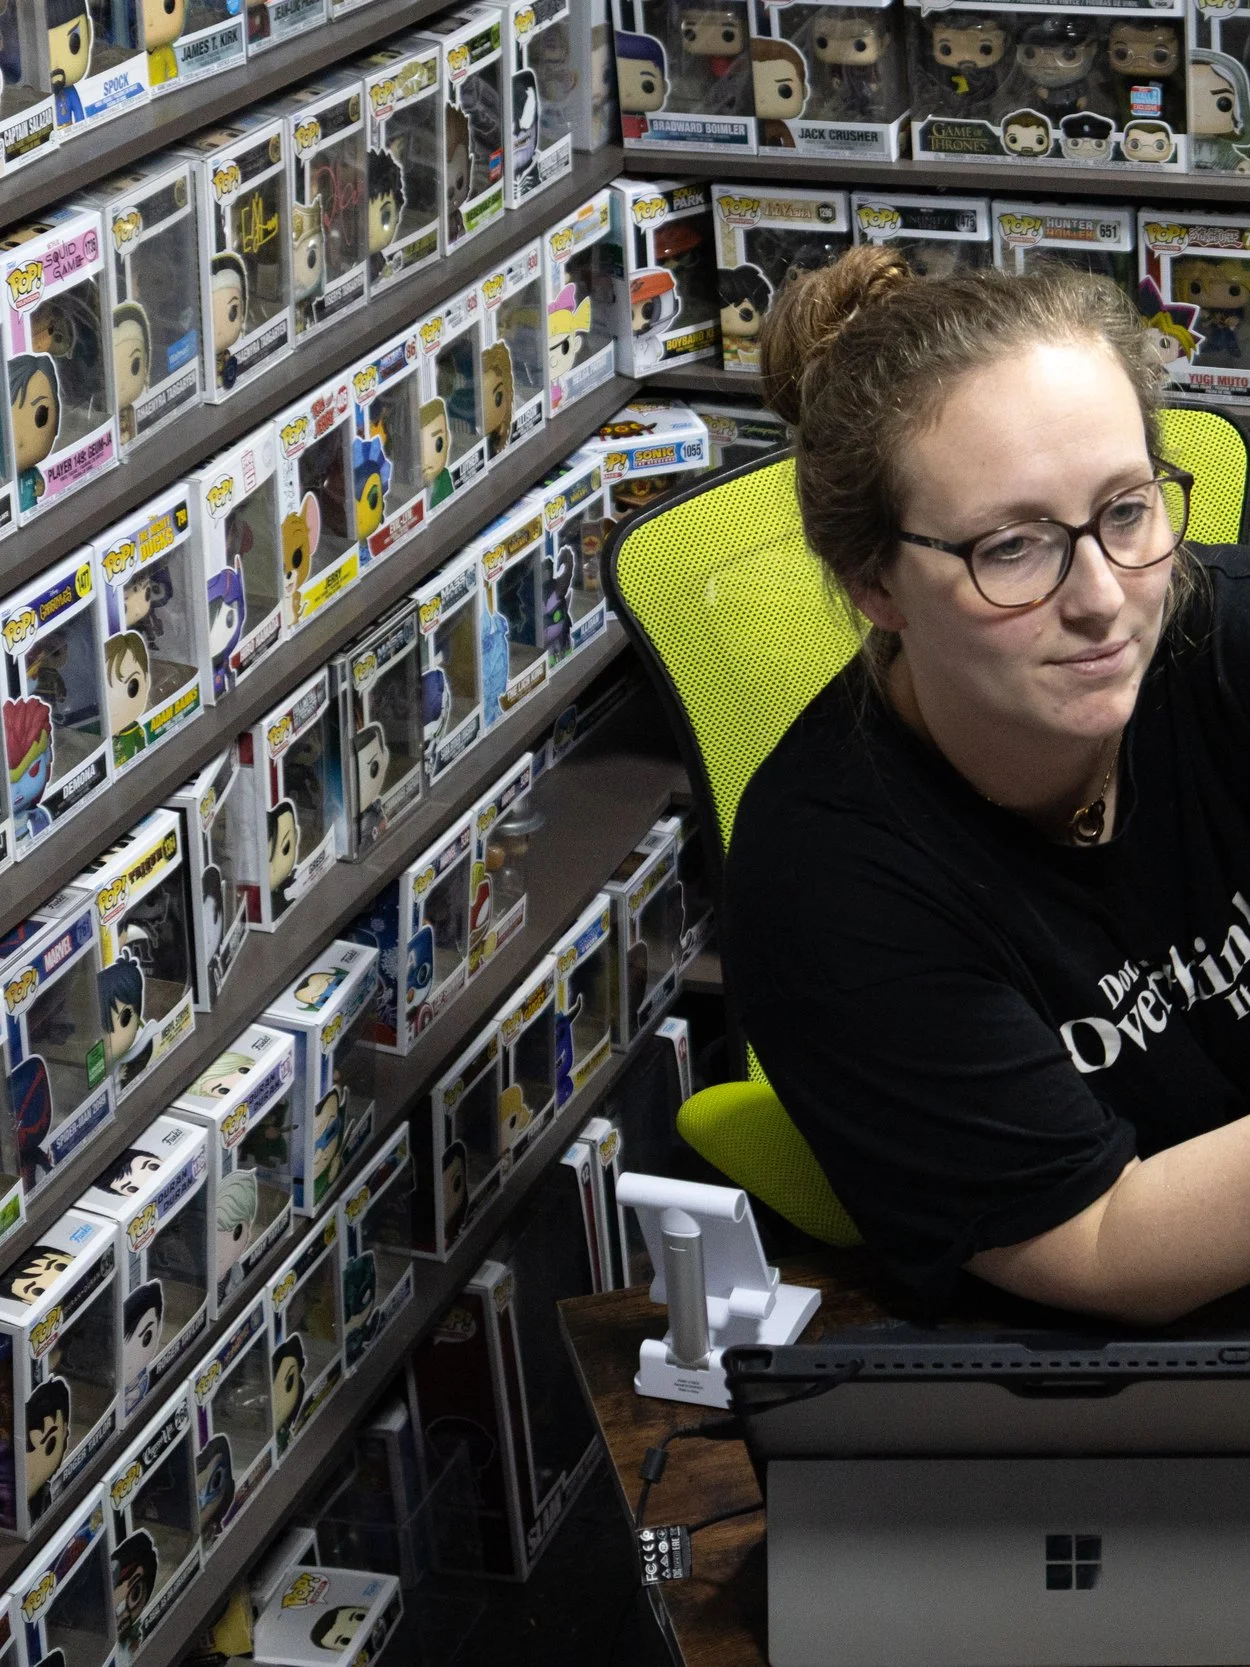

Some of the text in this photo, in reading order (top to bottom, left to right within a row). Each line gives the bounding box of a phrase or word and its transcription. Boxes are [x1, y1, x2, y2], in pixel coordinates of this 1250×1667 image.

[181, 28, 238, 61] JAMES KIRK
[103, 72, 129, 96] SPOCK
[3, 121, 28, 147] CAPTAIN
[294, 118, 321, 151] POP!
[652, 118, 746, 136] BRADWARD BOIMLER
[798, 127, 878, 143] JACK CRUSHER
[932, 121, 972, 138] GAME
[930, 137, 988, 153] THRONES
[213, 162, 240, 195] POP!
[631, 197, 666, 226] POP!
[673, 192, 705, 211] PARK
[857, 204, 901, 229] POP!
[1046, 216, 1093, 229] HUNTER
[1099, 222, 1117, 239] 651
[1144, 222, 1187, 245] POP!
[44, 241, 77, 268] SQUID
[53, 257, 84, 281] GAME
[6, 261, 42, 297] POP!
[1188, 373, 1249, 389] YUGI MUTO
[279, 417, 307, 447] POP!
[634, 451, 676, 466] SONIC
[682, 445, 701, 458] 1055
[48, 457, 72, 483] PLAYER
[544, 494, 567, 524] POP!
[102, 541, 136, 574] POP!
[140, 528, 174, 563] DUCKS
[418, 595, 441, 624] POP!
[150, 686, 198, 733] ADAM BANKS
[63, 766, 96, 800] DEMONA
[44, 936, 71, 972] MARVEL
[5, 968, 37, 1011] POP!
[320, 1011, 343, 1046] POP!
[250, 1034, 272, 1053] Funko
[55, 1114, 90, 1149] SPIDER-MAN
[220, 1104, 250, 1138] POP!
[161, 1127, 184, 1148] Funko
[157, 1167, 188, 1203] DURAN
[163, 1178, 194, 1213] DURAN
[69, 1222, 94, 1245] Funko
[271, 1271, 297, 1311] POP!
[28, 1305, 63, 1345] POP!
[63, 1449, 88, 1480] ROGER
[21, 1572, 55, 1620] POP!
[281, 1572, 321, 1609] POP!
